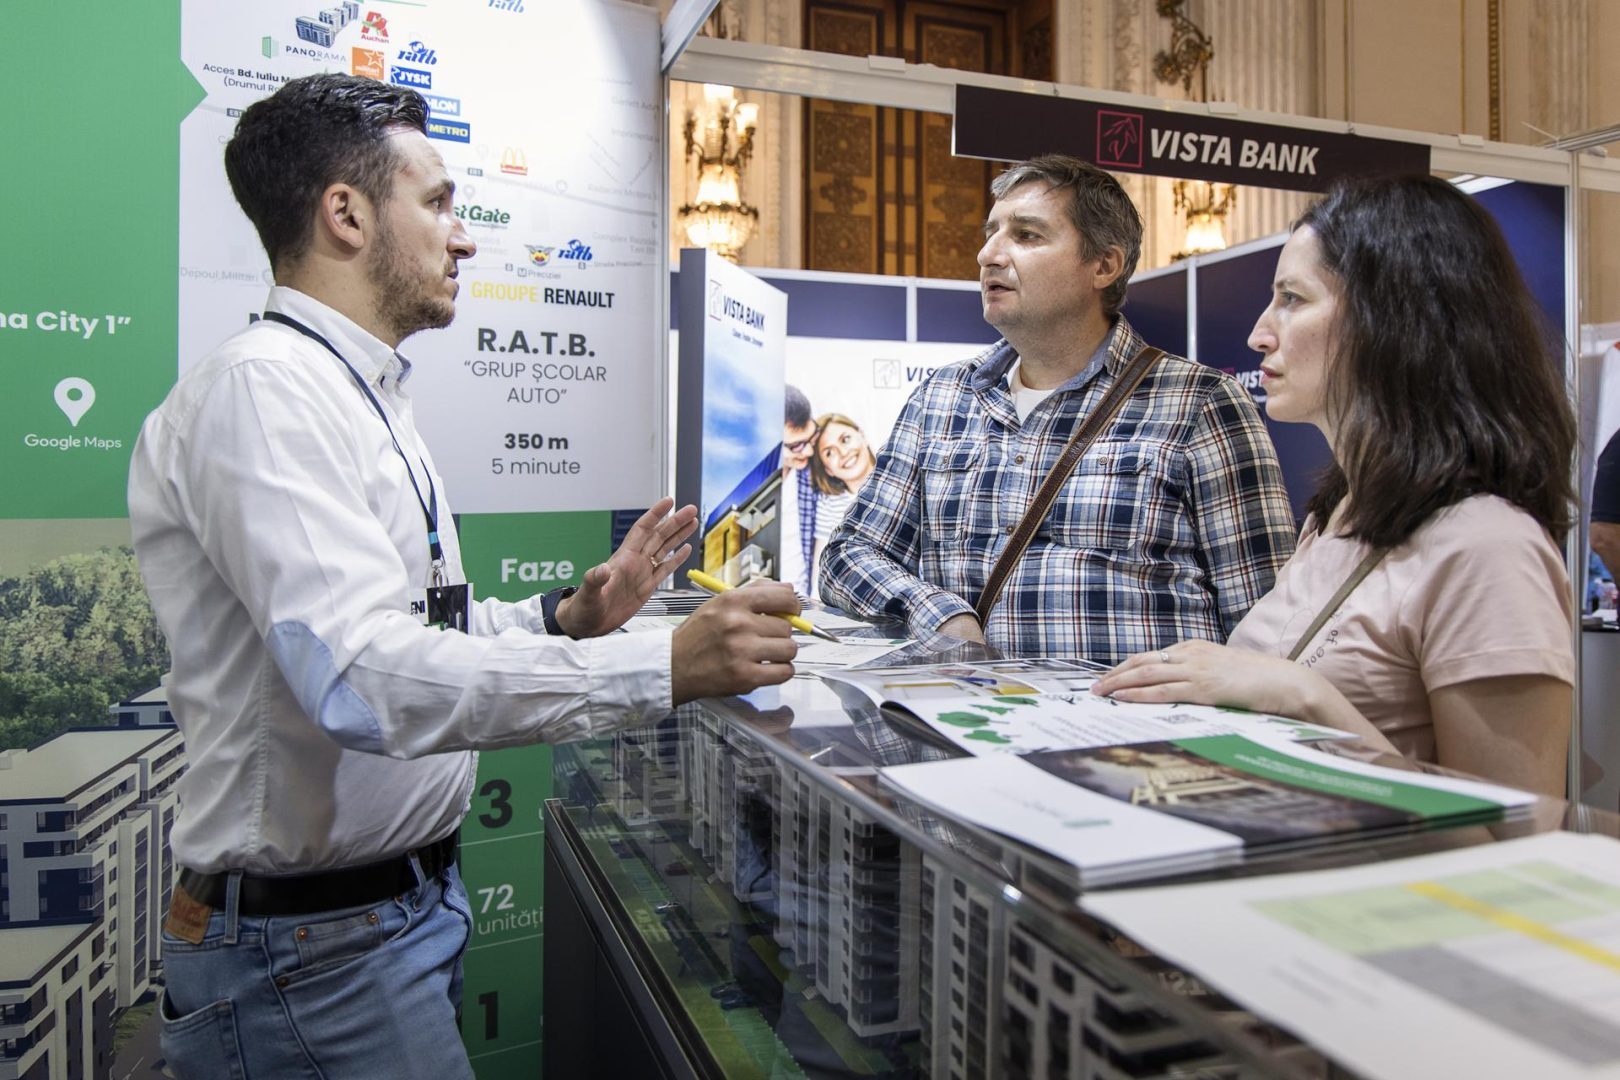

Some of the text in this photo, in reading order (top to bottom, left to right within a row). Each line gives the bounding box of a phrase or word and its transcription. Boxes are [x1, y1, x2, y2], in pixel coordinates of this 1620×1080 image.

[361, 34, 389, 44] Auchan
[286, 45, 347, 62] PANORAMA
[203, 63, 235, 76] Acces
[237, 68, 254, 79] Bd.
[256, 71, 279, 83] Iuliu
[399, 71, 431, 86] JYSK
[223, 75, 281, 92] (Drumul Ro
[429, 124, 468, 137] METRO
[1151, 128, 1320, 175] VISTA BANK
[469, 205, 510, 224] Gate
[471, 281, 615, 308] GROUPE RENAULT
[723, 295, 765, 331] VISTA BANK
[36, 310, 99, 339] City
[477, 327, 596, 357] R.A.T.B.
[532, 363, 607, 383] ȘCOLAR
[906, 367, 935, 382] VIS
[1236, 370, 1264, 388] VIST
[24, 433, 122, 451] Google Maps
[504, 433, 569, 450] 350 m
[491, 457, 581, 475] 5 minute
[501, 558, 574, 583] Faze
[478, 778, 513, 829] 3
[477, 883, 515, 914] 72
[478, 906, 544, 936] unități
[478, 991, 499, 1040] 1
